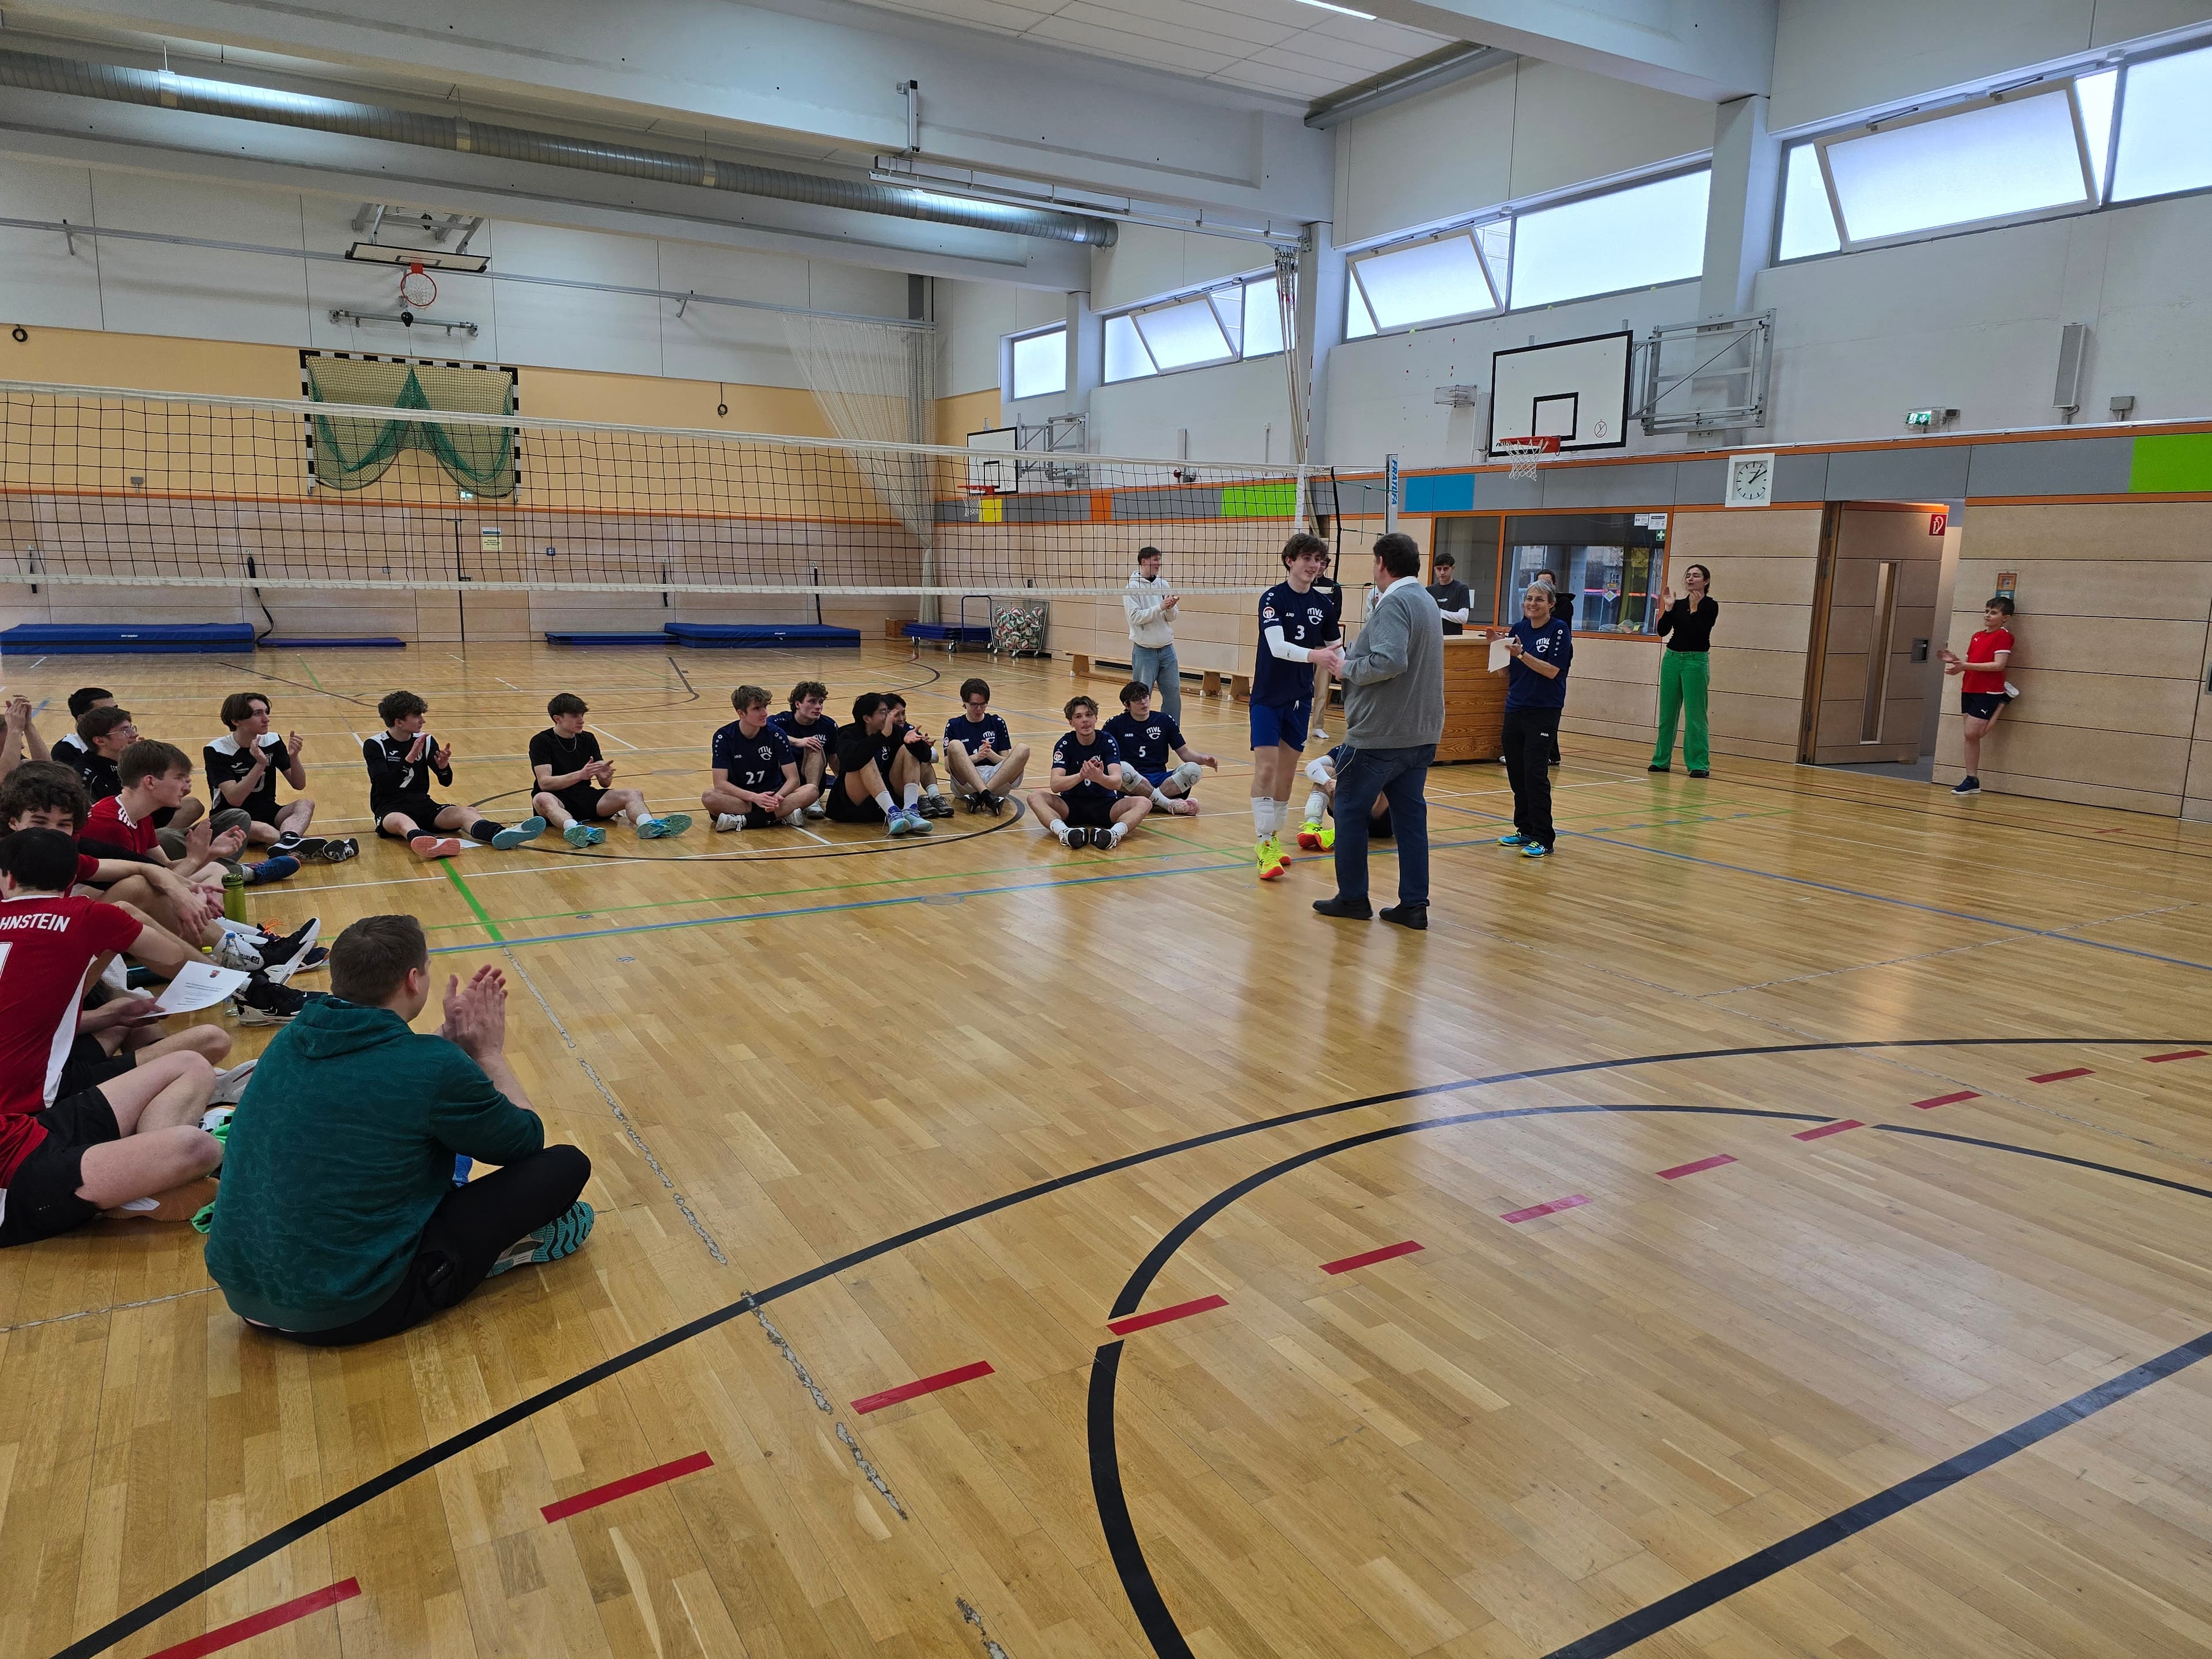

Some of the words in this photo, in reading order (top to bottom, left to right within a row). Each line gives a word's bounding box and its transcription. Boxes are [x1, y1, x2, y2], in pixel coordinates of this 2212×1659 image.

[1294, 625, 1305, 640] 3
[1139, 746, 1146, 757] 5
[745, 770, 765, 785] 27
